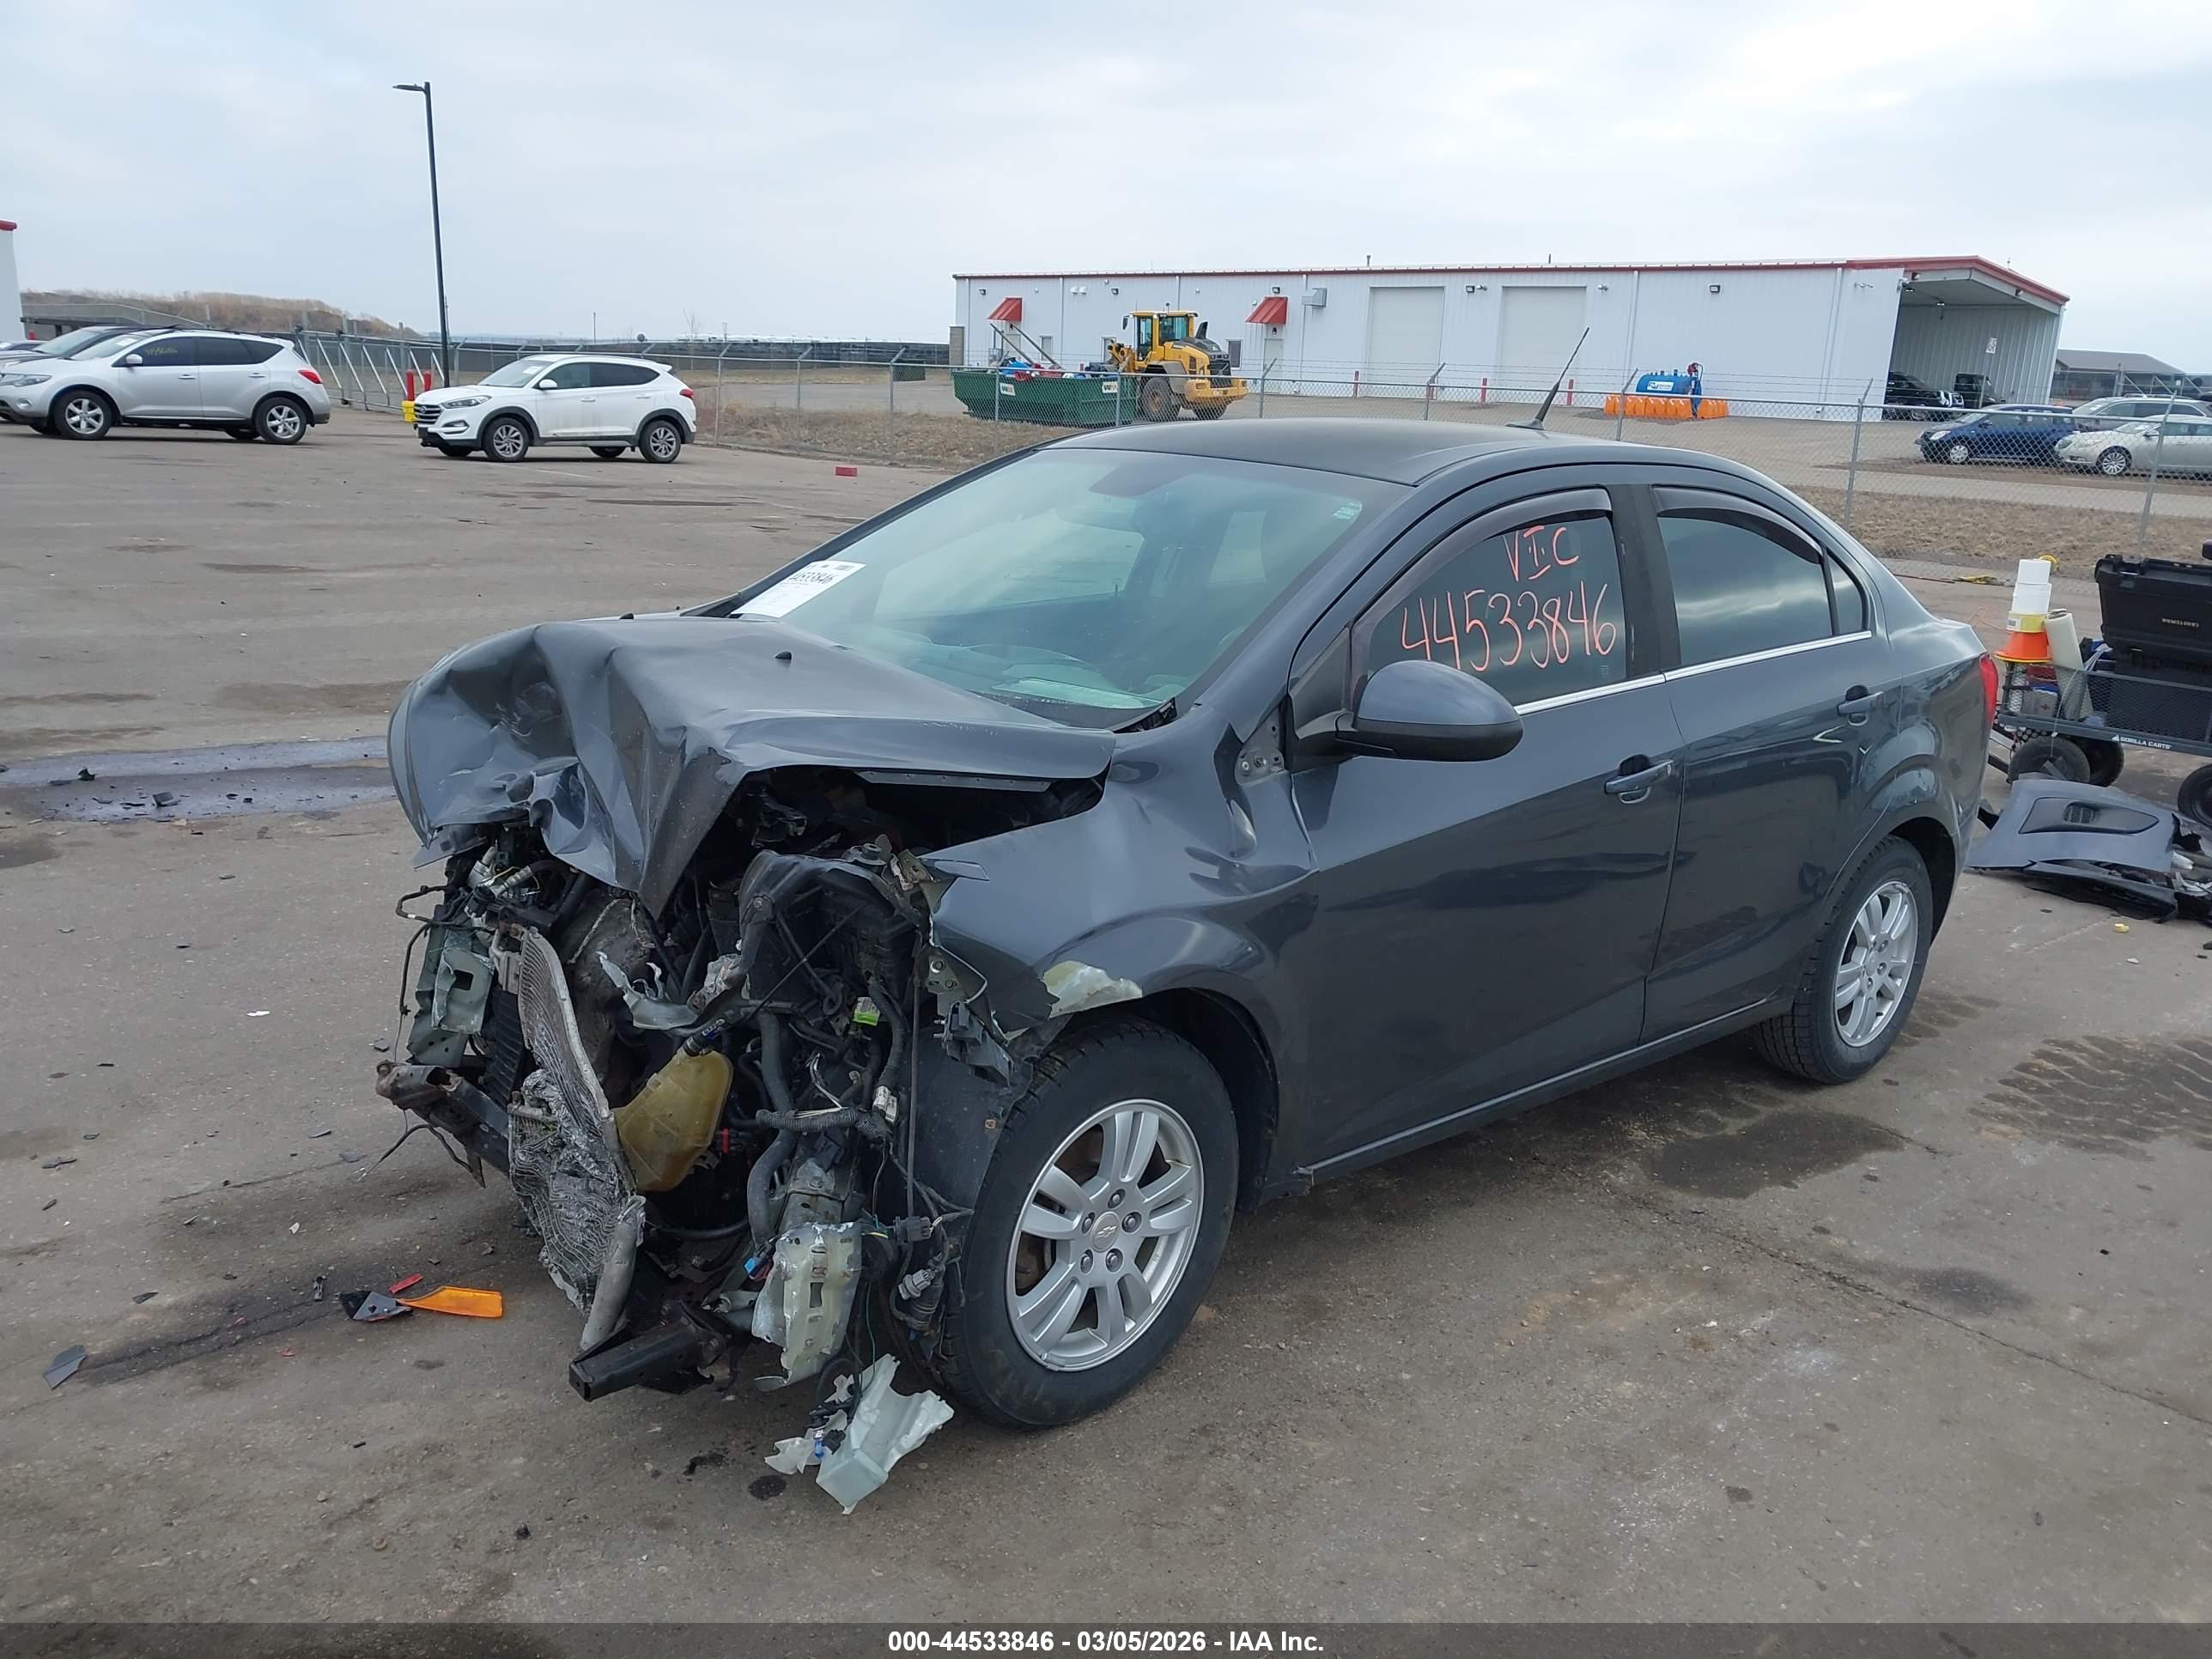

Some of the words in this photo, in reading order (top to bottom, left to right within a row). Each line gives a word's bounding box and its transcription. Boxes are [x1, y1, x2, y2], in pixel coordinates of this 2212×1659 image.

[1504, 526, 1579, 582] VIC
[1401, 580, 1616, 672] 44533846
[2119, 736, 2148, 747] GORILLA
